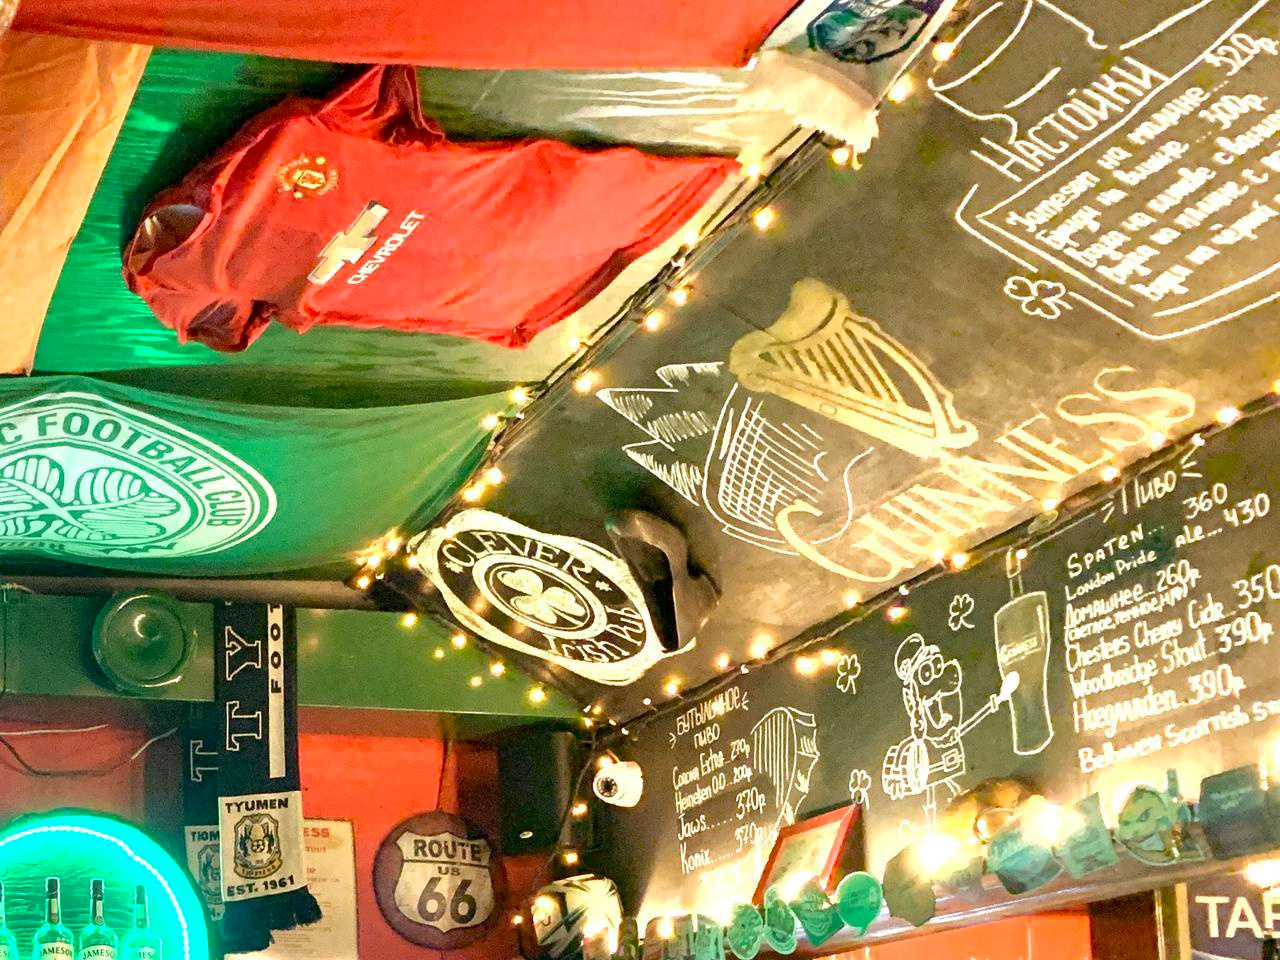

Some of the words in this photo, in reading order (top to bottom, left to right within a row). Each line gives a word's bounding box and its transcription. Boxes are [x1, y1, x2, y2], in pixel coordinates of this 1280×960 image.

[347, 210, 425, 285] CHEVROLET
[37, 410, 226, 490] FOOTBALL
[205, 488, 241, 527] CLUB
[1182, 483, 1228, 519] 360
[1115, 549, 1157, 576] Pride
[1223, 493, 1270, 527] 430
[441, 531, 593, 585] CLEVER
[225, 798, 289, 813] TYUMEN
[413, 839, 482, 861] ROUTE
[227, 883, 258, 897] EST.
[263, 875, 295, 891] 1961
[438, 866, 461, 876] US
[418, 877, 477, 924] 66
